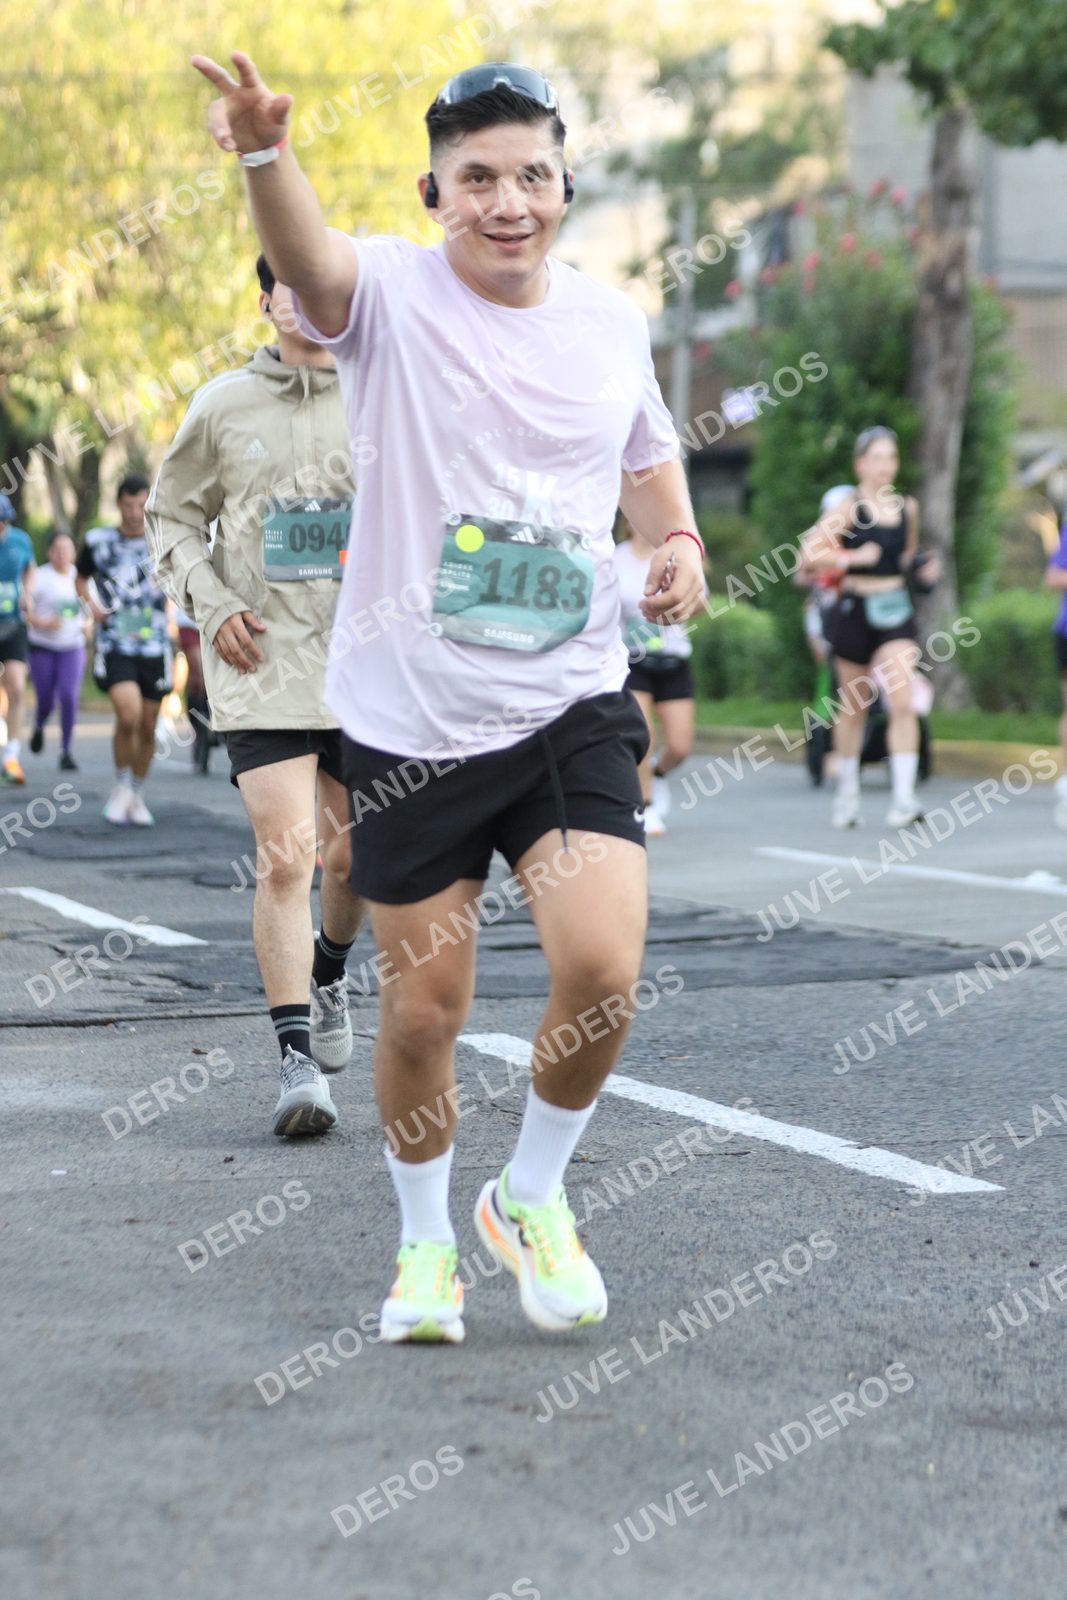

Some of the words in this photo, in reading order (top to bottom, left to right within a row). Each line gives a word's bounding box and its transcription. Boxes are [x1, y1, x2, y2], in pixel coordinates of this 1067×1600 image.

[289, 522, 350, 553] 094
[298, 567, 333, 576] SAMSUNG
[478, 558, 587, 615] 1183
[483, 628, 535, 644] SAMSUNG
